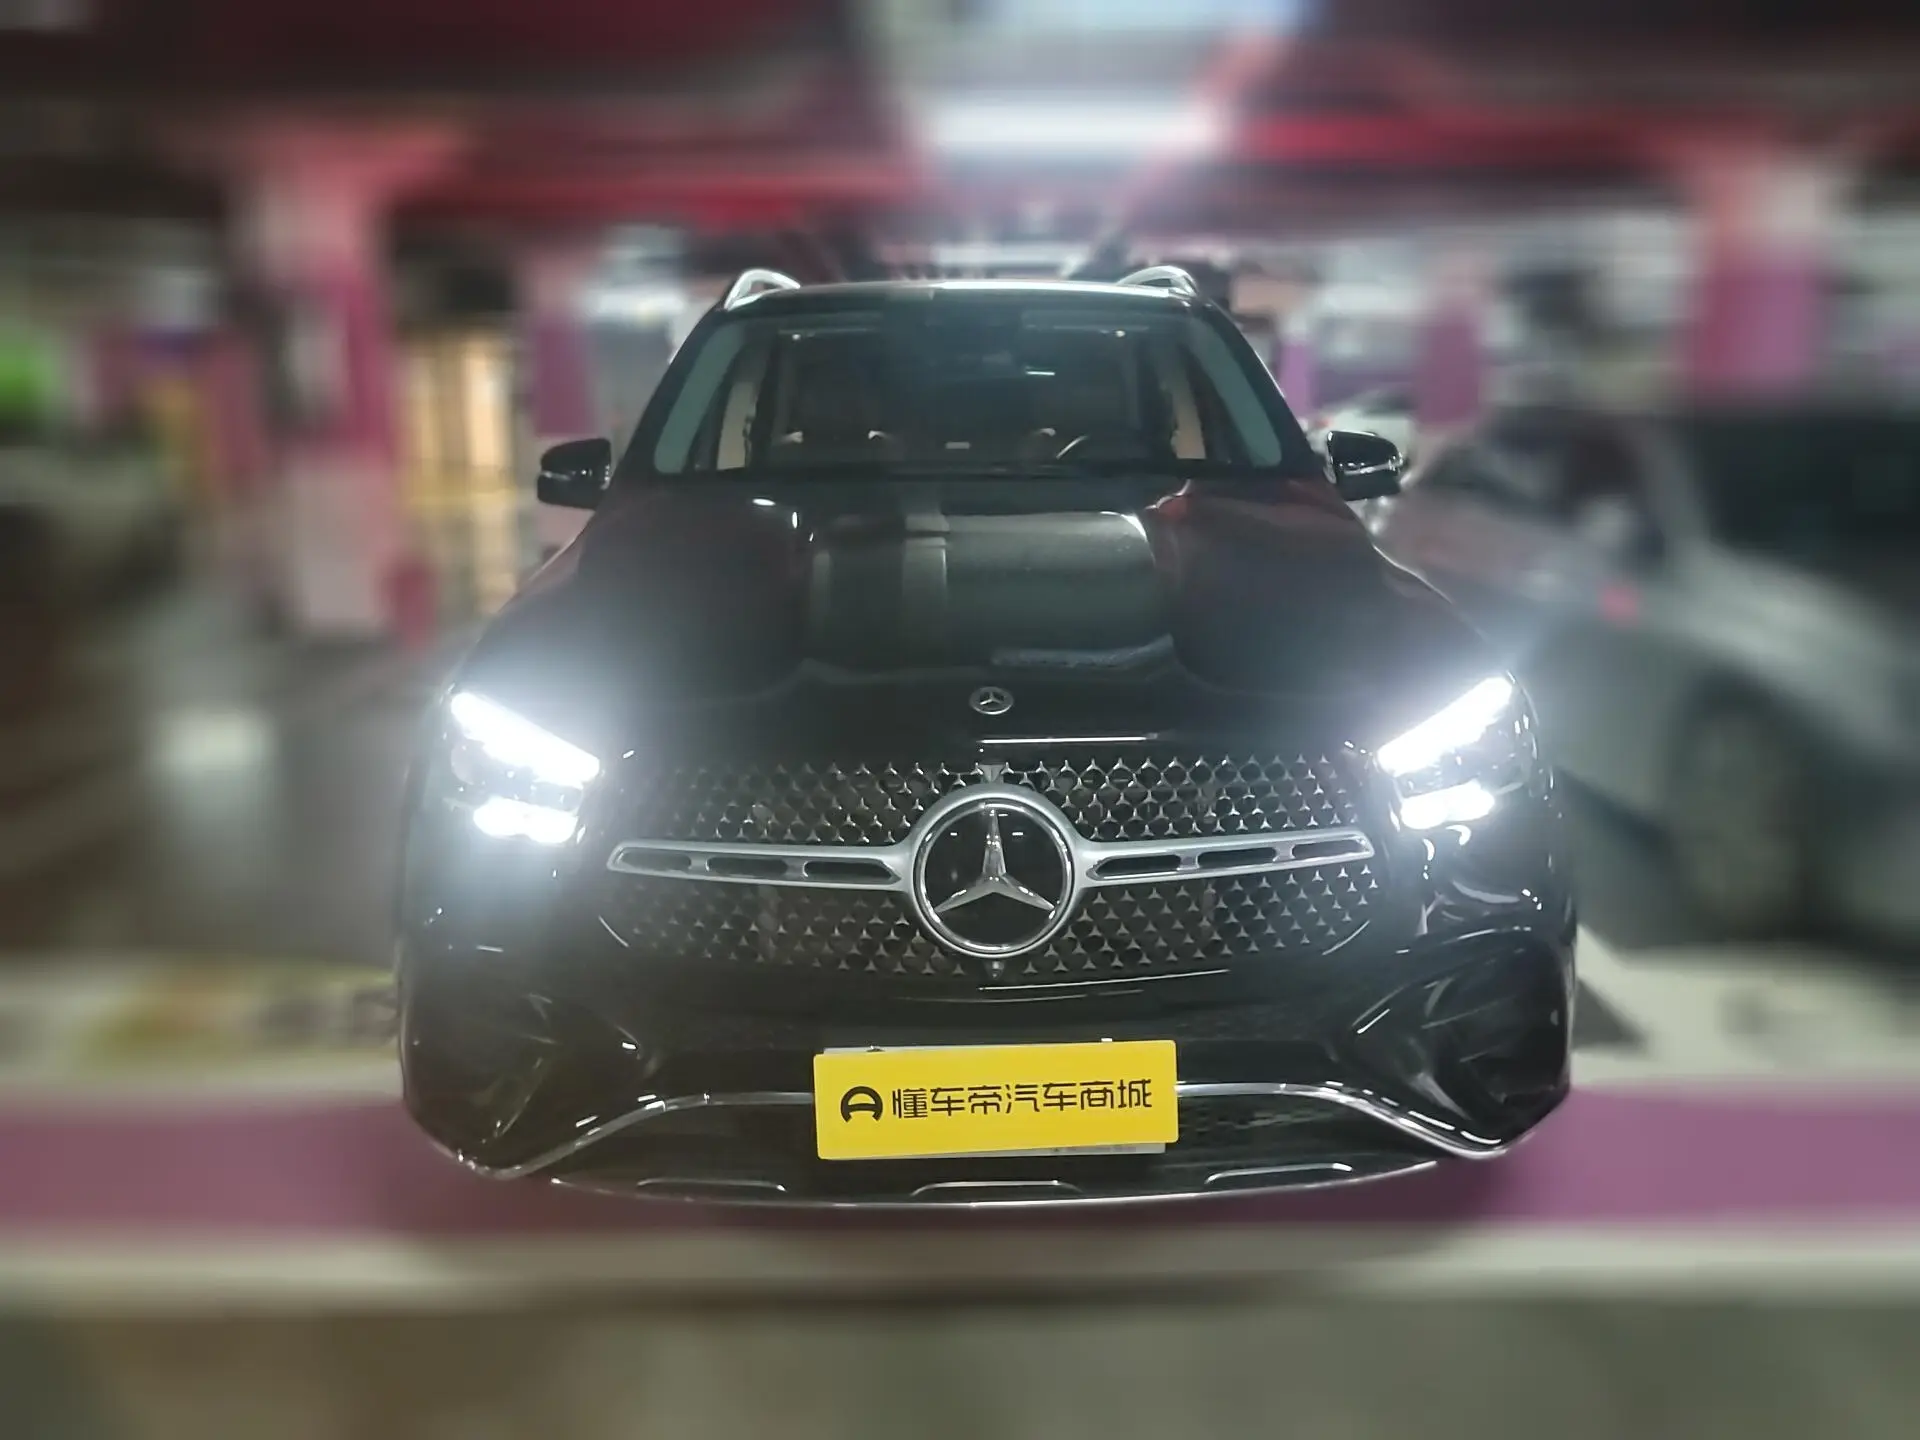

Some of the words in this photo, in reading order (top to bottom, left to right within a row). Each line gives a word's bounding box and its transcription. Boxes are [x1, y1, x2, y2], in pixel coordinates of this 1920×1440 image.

[892, 1078, 1152, 1119] 懂车帝汽车商城
